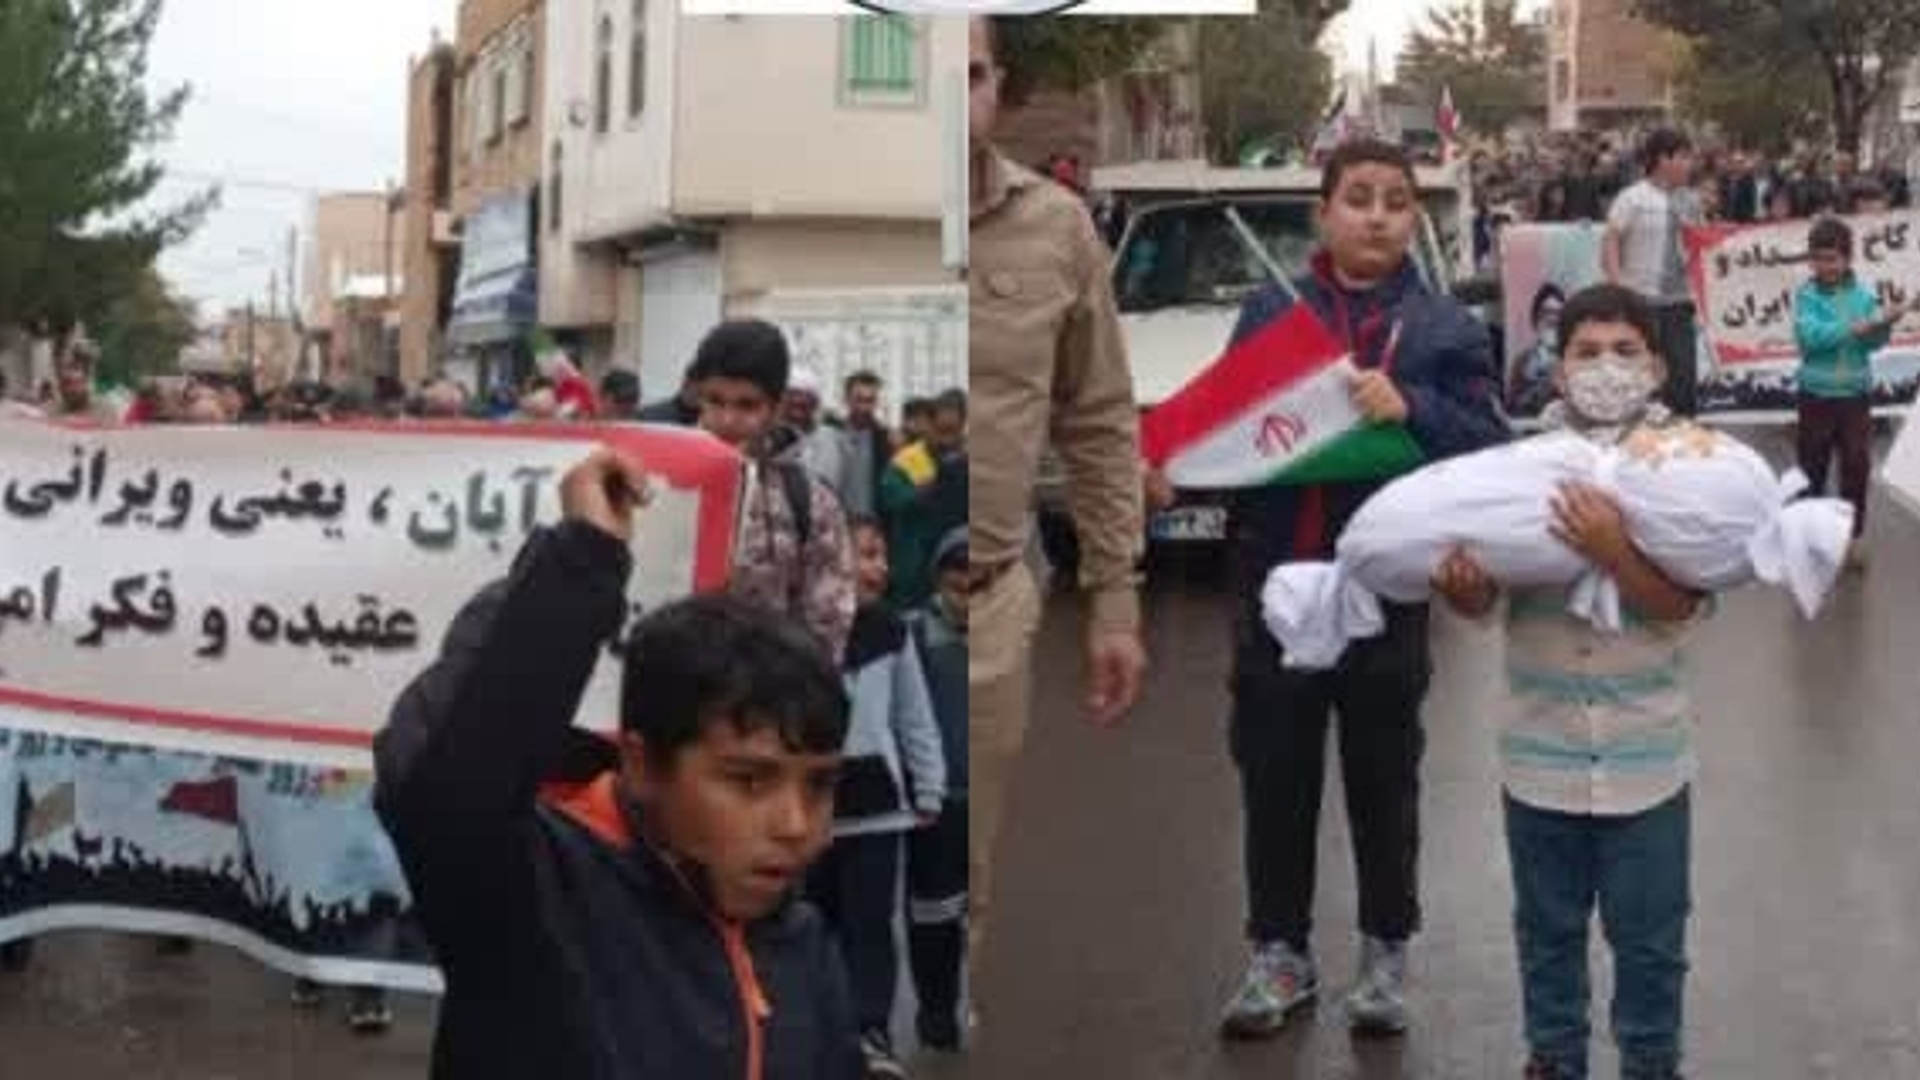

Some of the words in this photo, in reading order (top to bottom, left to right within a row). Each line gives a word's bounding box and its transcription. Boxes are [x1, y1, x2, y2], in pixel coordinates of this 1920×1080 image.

[1715, 253, 1730, 279] و
[1722, 288, 1791, 328] ایران
[4, 444, 193, 529] ویرانی
[210, 467, 346, 538] یعنی
[406, 465, 552, 551] آبان
[75, 570, 176, 647] فکر
[195, 605, 228, 658] و
[248, 594, 418, 666] عقیده
